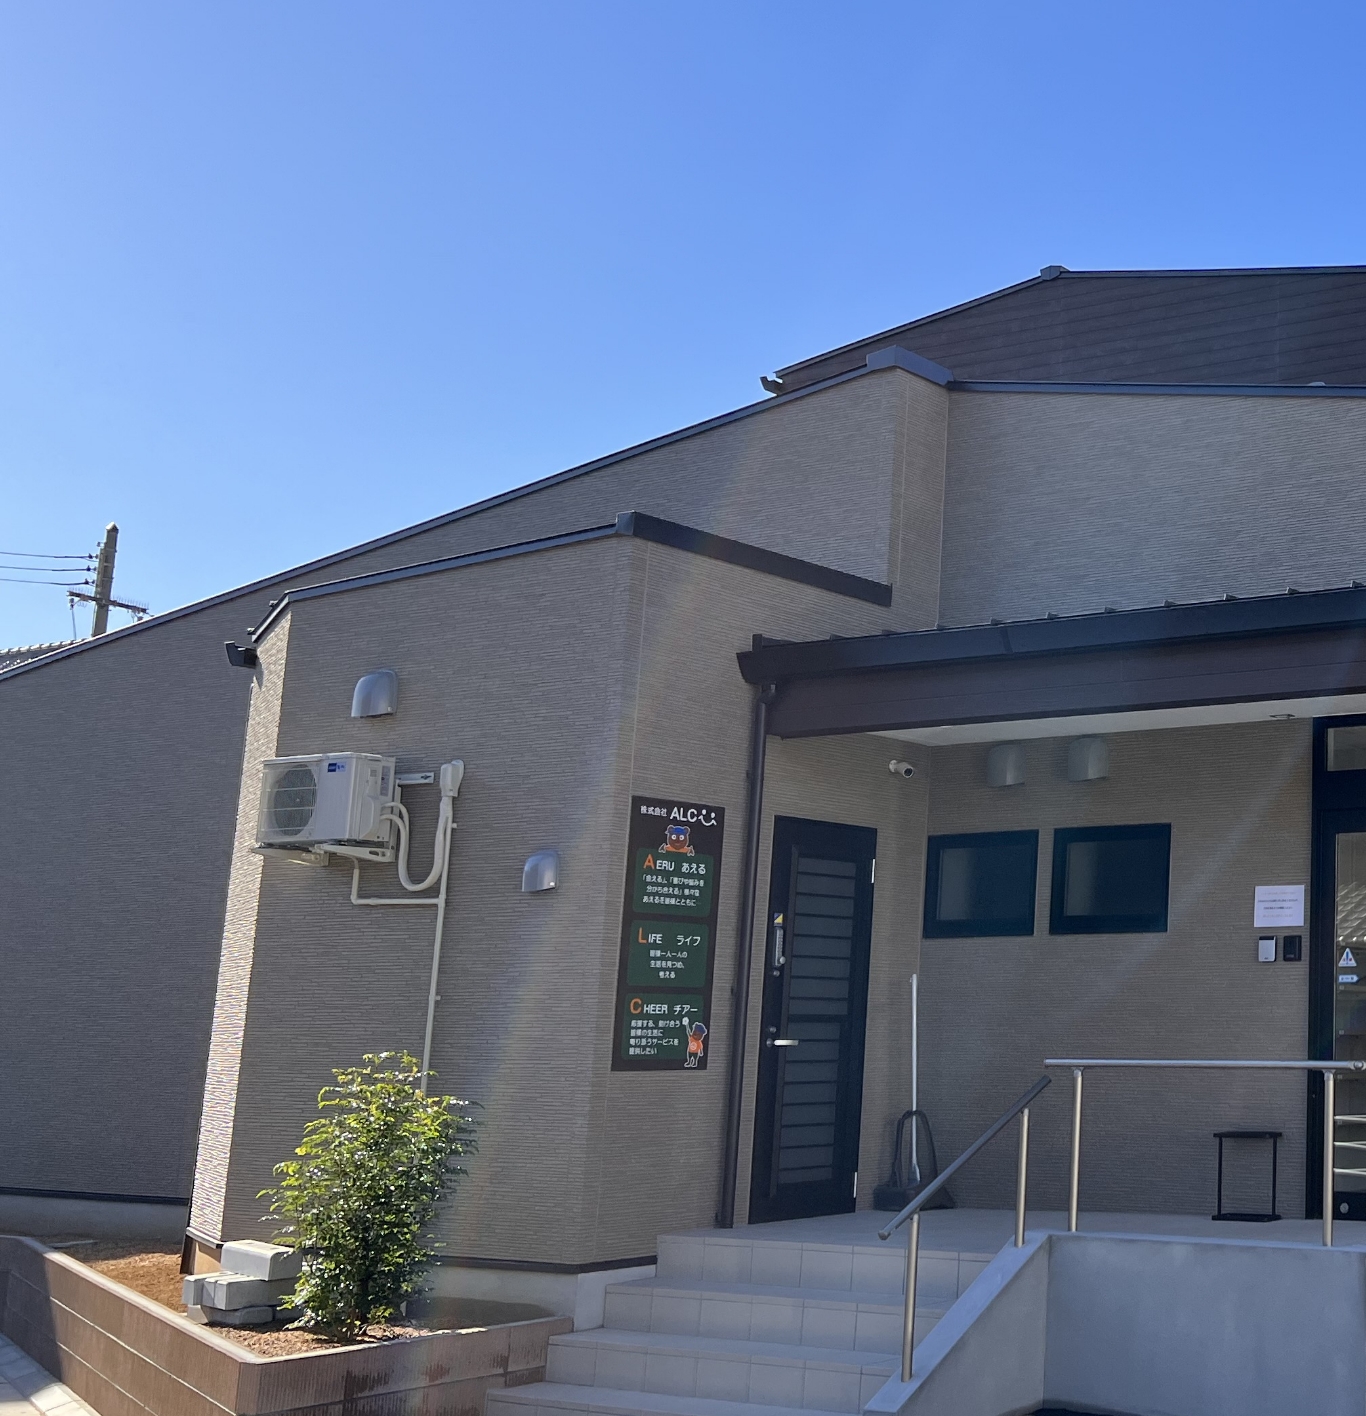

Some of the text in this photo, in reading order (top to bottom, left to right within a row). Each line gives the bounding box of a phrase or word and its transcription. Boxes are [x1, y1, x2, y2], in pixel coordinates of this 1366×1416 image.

[643, 853, 706, 874] AERU あえる
[638, 927, 701, 946] LIFE ライフ
[630, 998, 698, 1015] CHEER チアー
